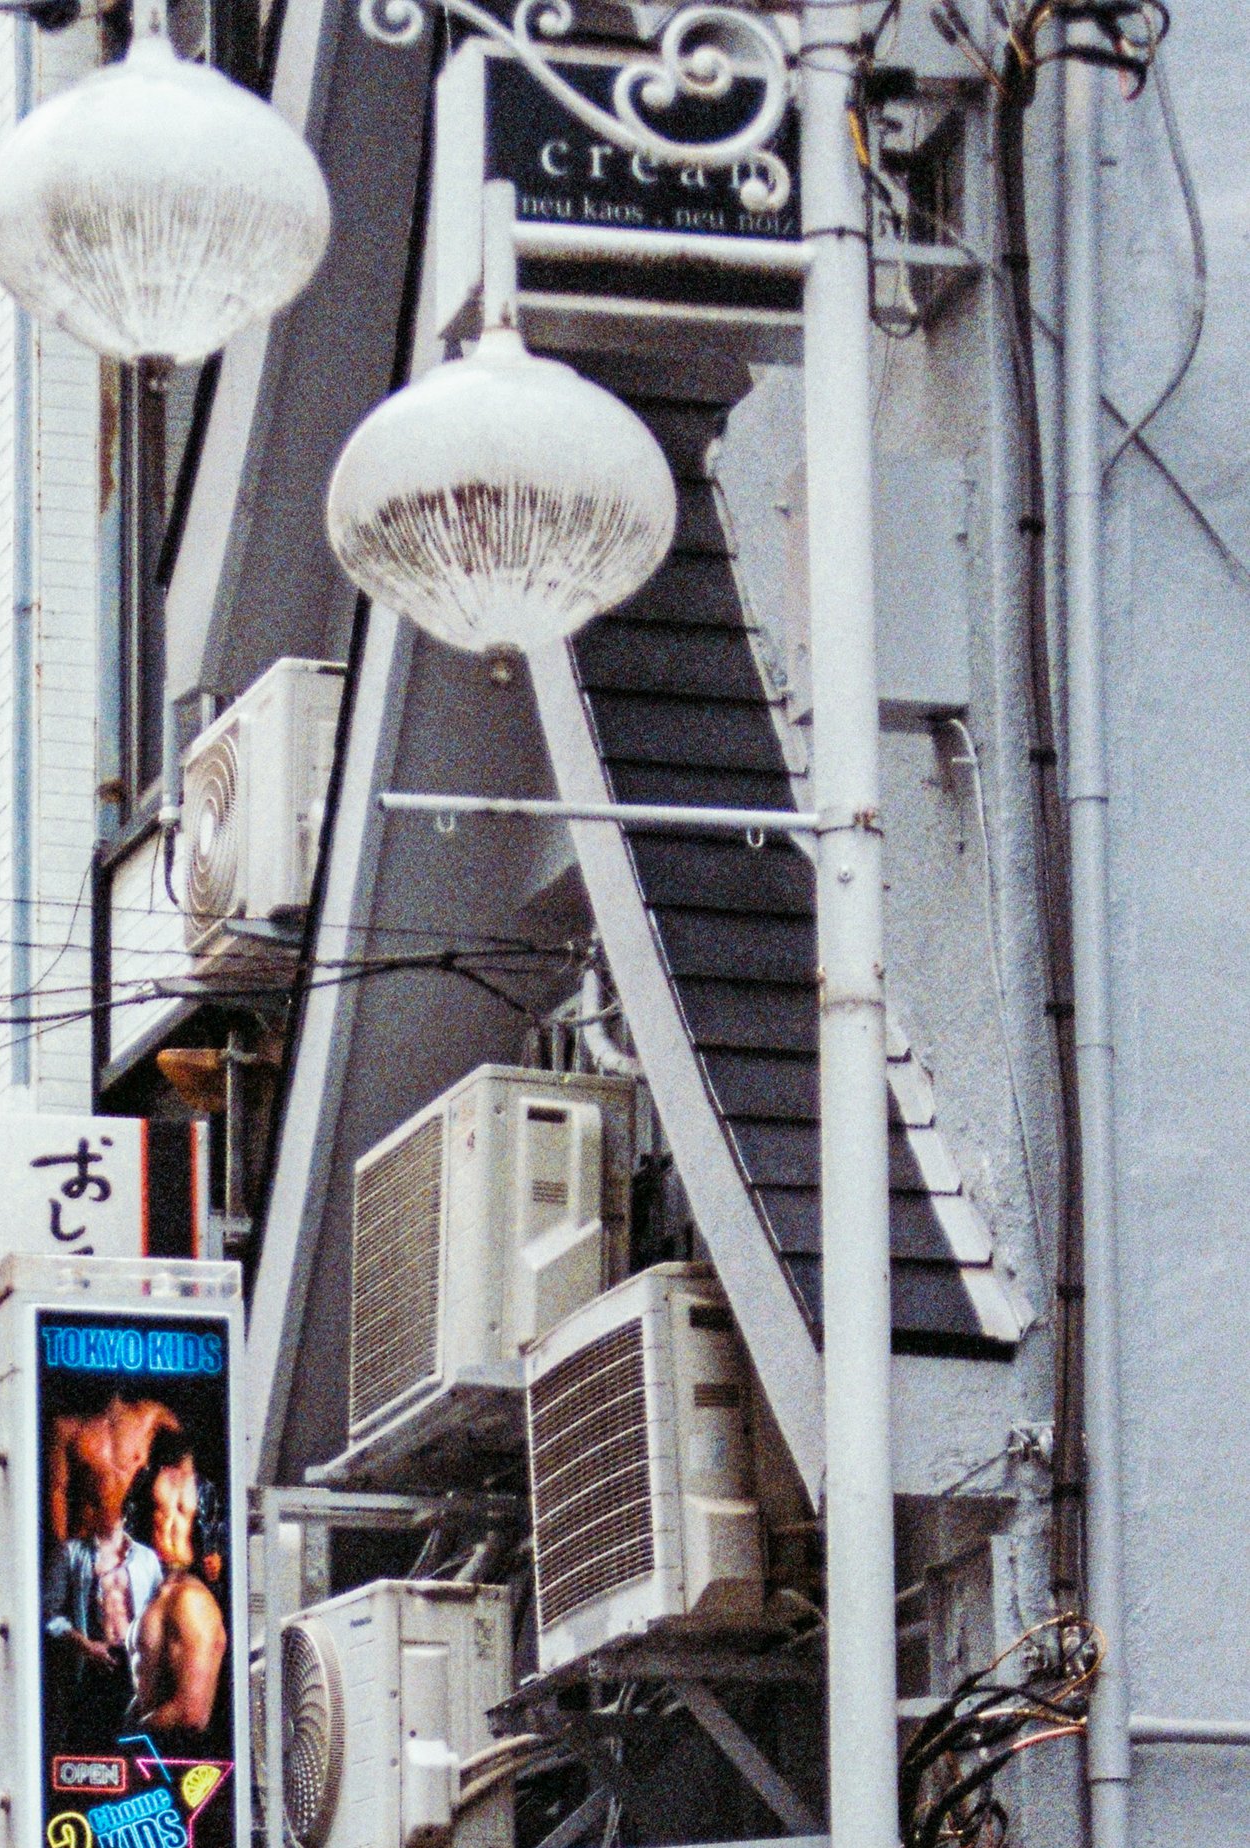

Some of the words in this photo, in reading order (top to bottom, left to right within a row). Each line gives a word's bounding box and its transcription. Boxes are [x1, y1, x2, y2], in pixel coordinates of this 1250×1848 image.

[30, 1136, 114, 1256] おし
[43, 1325, 144, 1371] TOKYO
[147, 1330, 223, 1374] KIDS
[60, 1762, 119, 1786] OPEN
[88, 1787, 173, 1833] Chome
